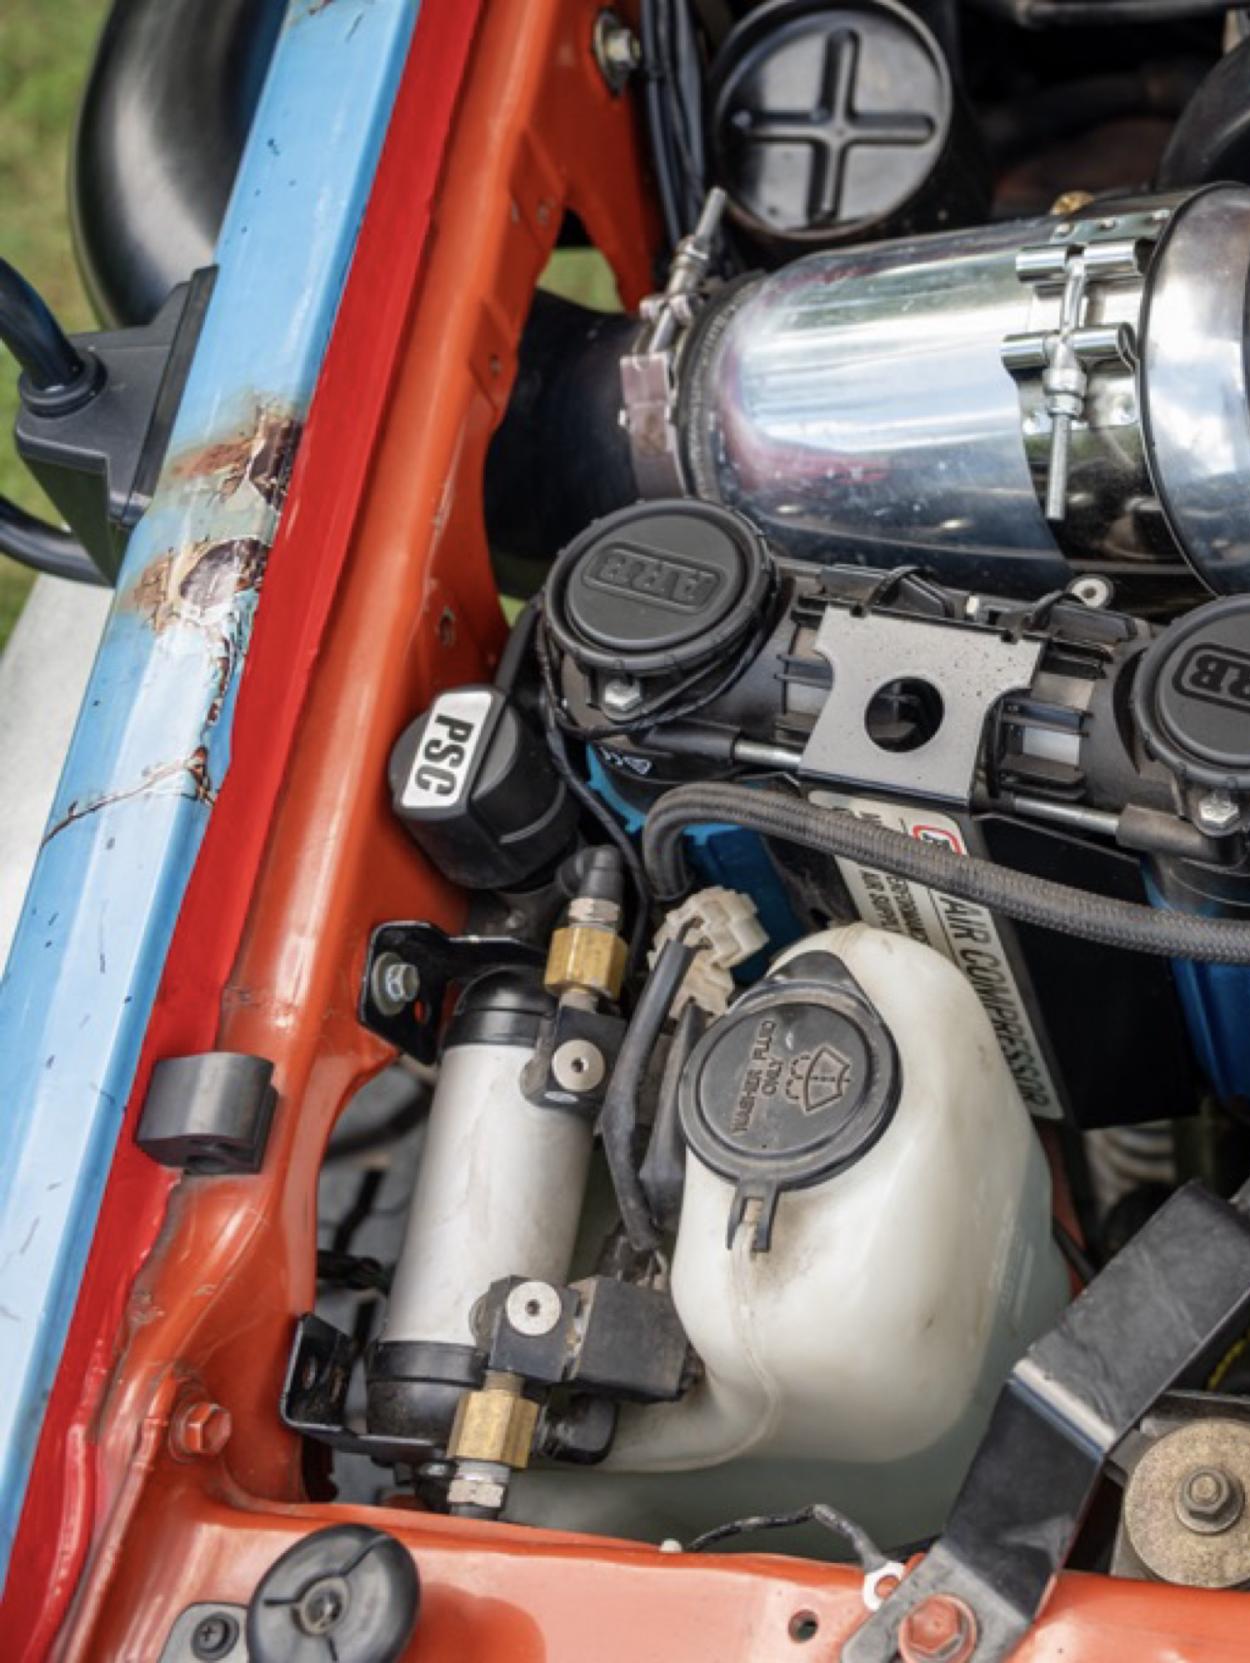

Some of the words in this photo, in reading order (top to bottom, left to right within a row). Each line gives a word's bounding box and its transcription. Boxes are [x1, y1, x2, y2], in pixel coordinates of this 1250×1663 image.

[414, 713, 475, 796] PSC
[940, 895, 990, 944] AIR
[752, 1020, 776, 1060] FLUID
[959, 949, 1050, 1107] COMPRESSOR
[761, 1057, 784, 1095] ONLY
